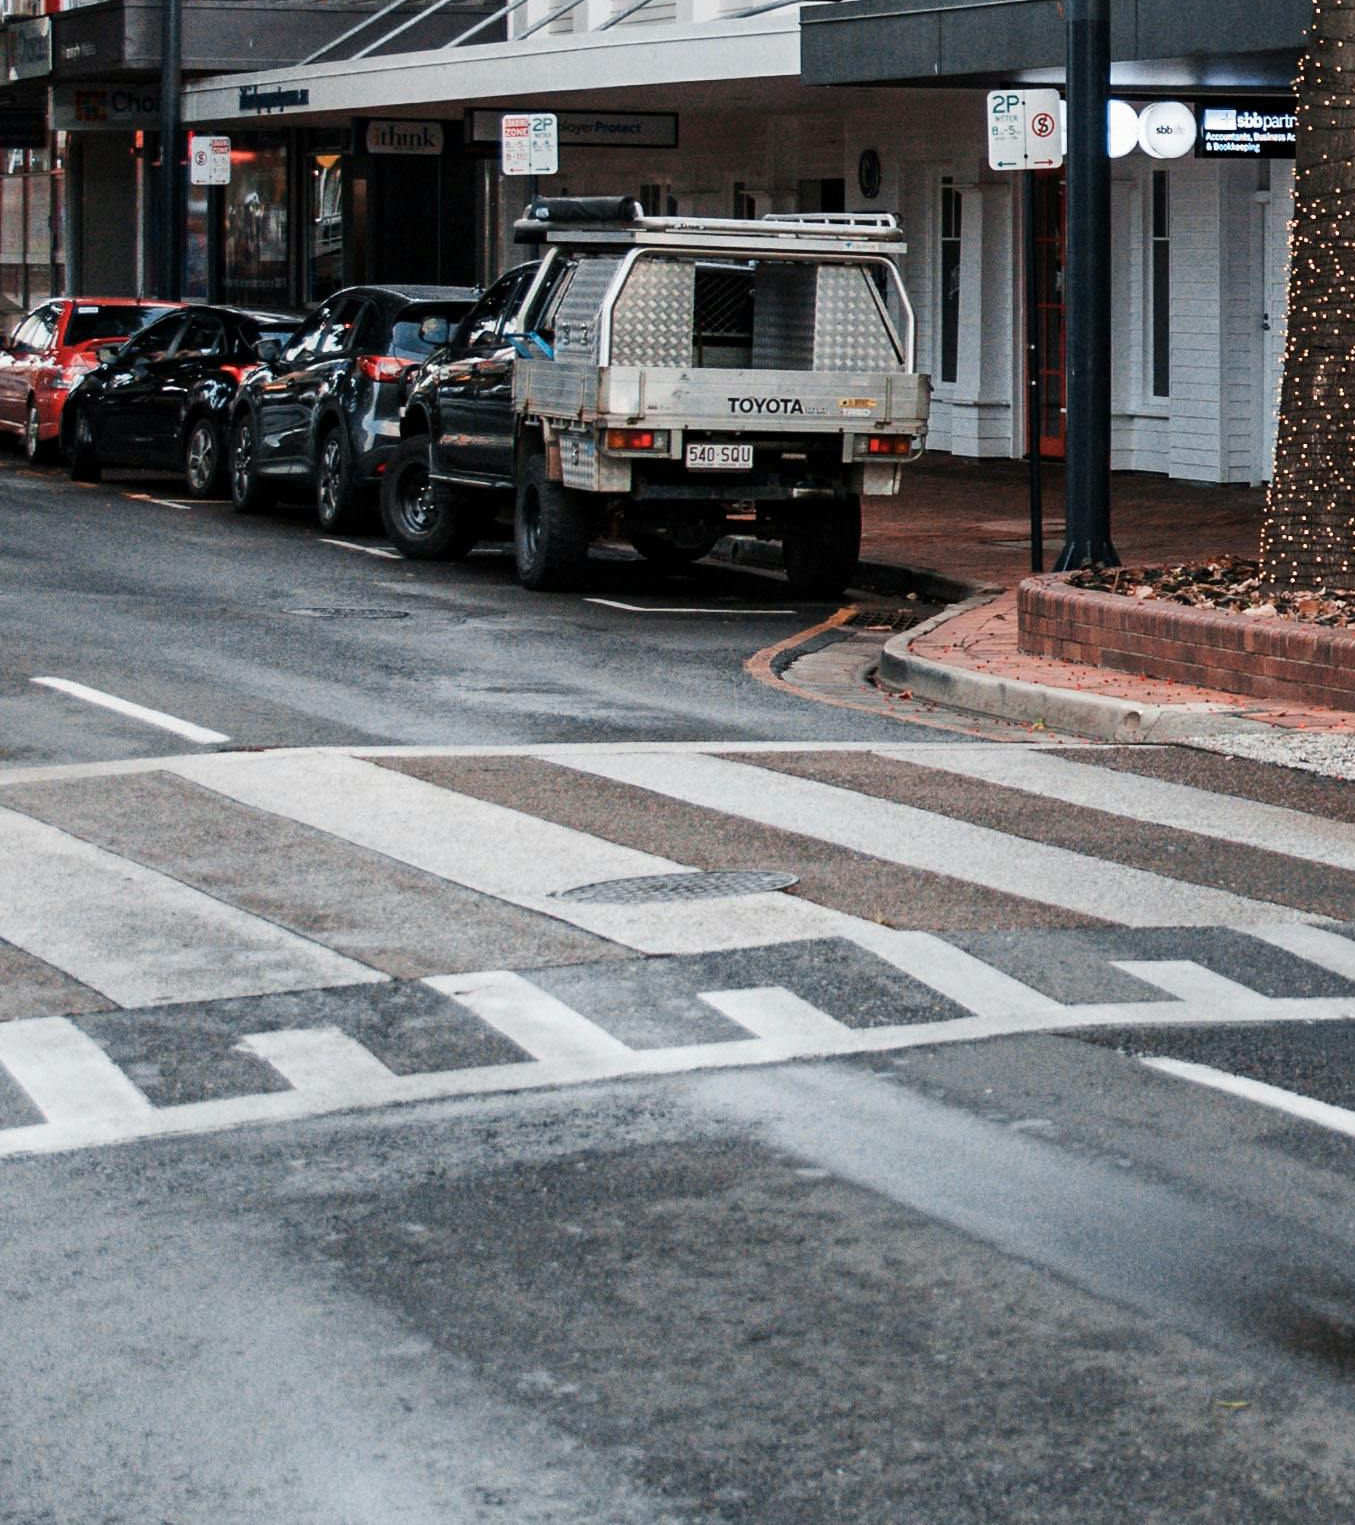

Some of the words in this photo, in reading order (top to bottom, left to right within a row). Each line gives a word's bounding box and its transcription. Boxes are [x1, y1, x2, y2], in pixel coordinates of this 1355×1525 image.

[992, 95, 1020, 113] 2P
[533, 118, 553, 131] 2P
[728, 397, 804, 415] TOYOTA
[690, 447, 715, 463] 540
[721, 447, 751, 463] SQU
